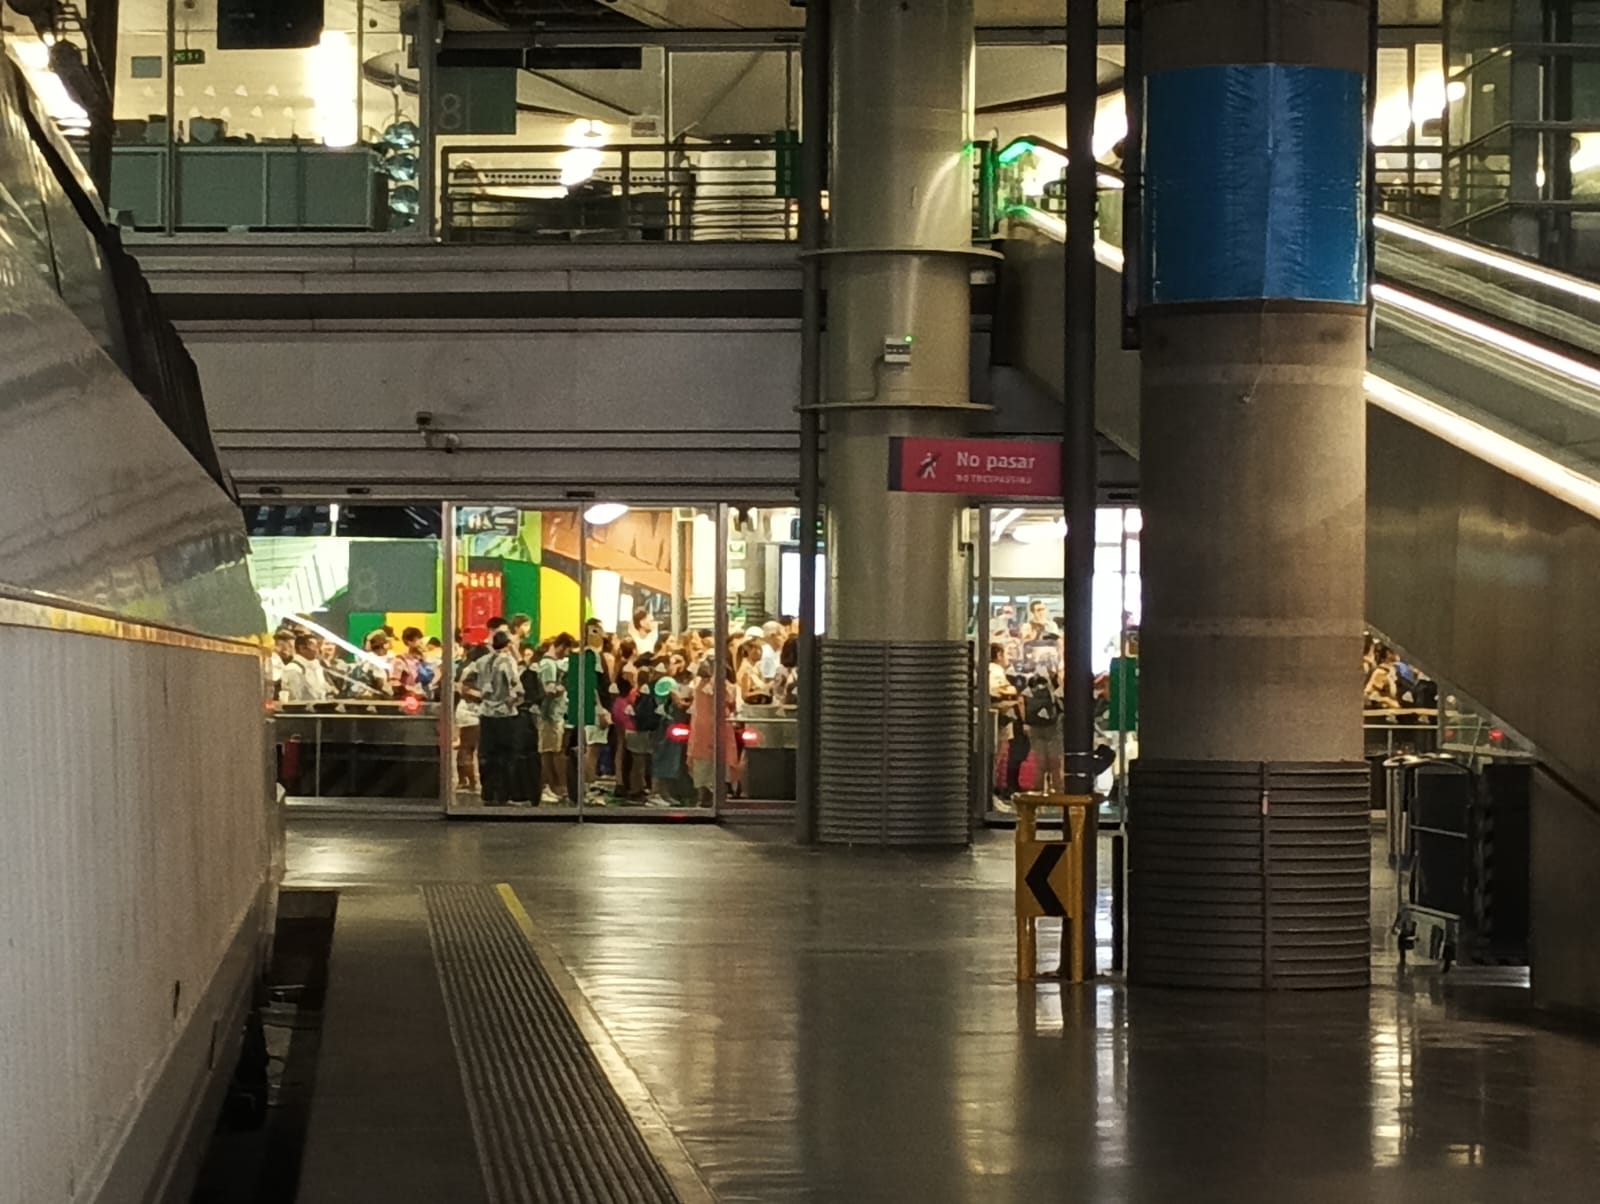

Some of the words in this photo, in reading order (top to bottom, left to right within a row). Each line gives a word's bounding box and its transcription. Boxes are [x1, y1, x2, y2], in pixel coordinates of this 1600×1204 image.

[440, 93, 462, 130] 8
[956, 451, 980, 468] No
[986, 455, 1036, 472] pasar
[354, 567, 379, 609] 8
